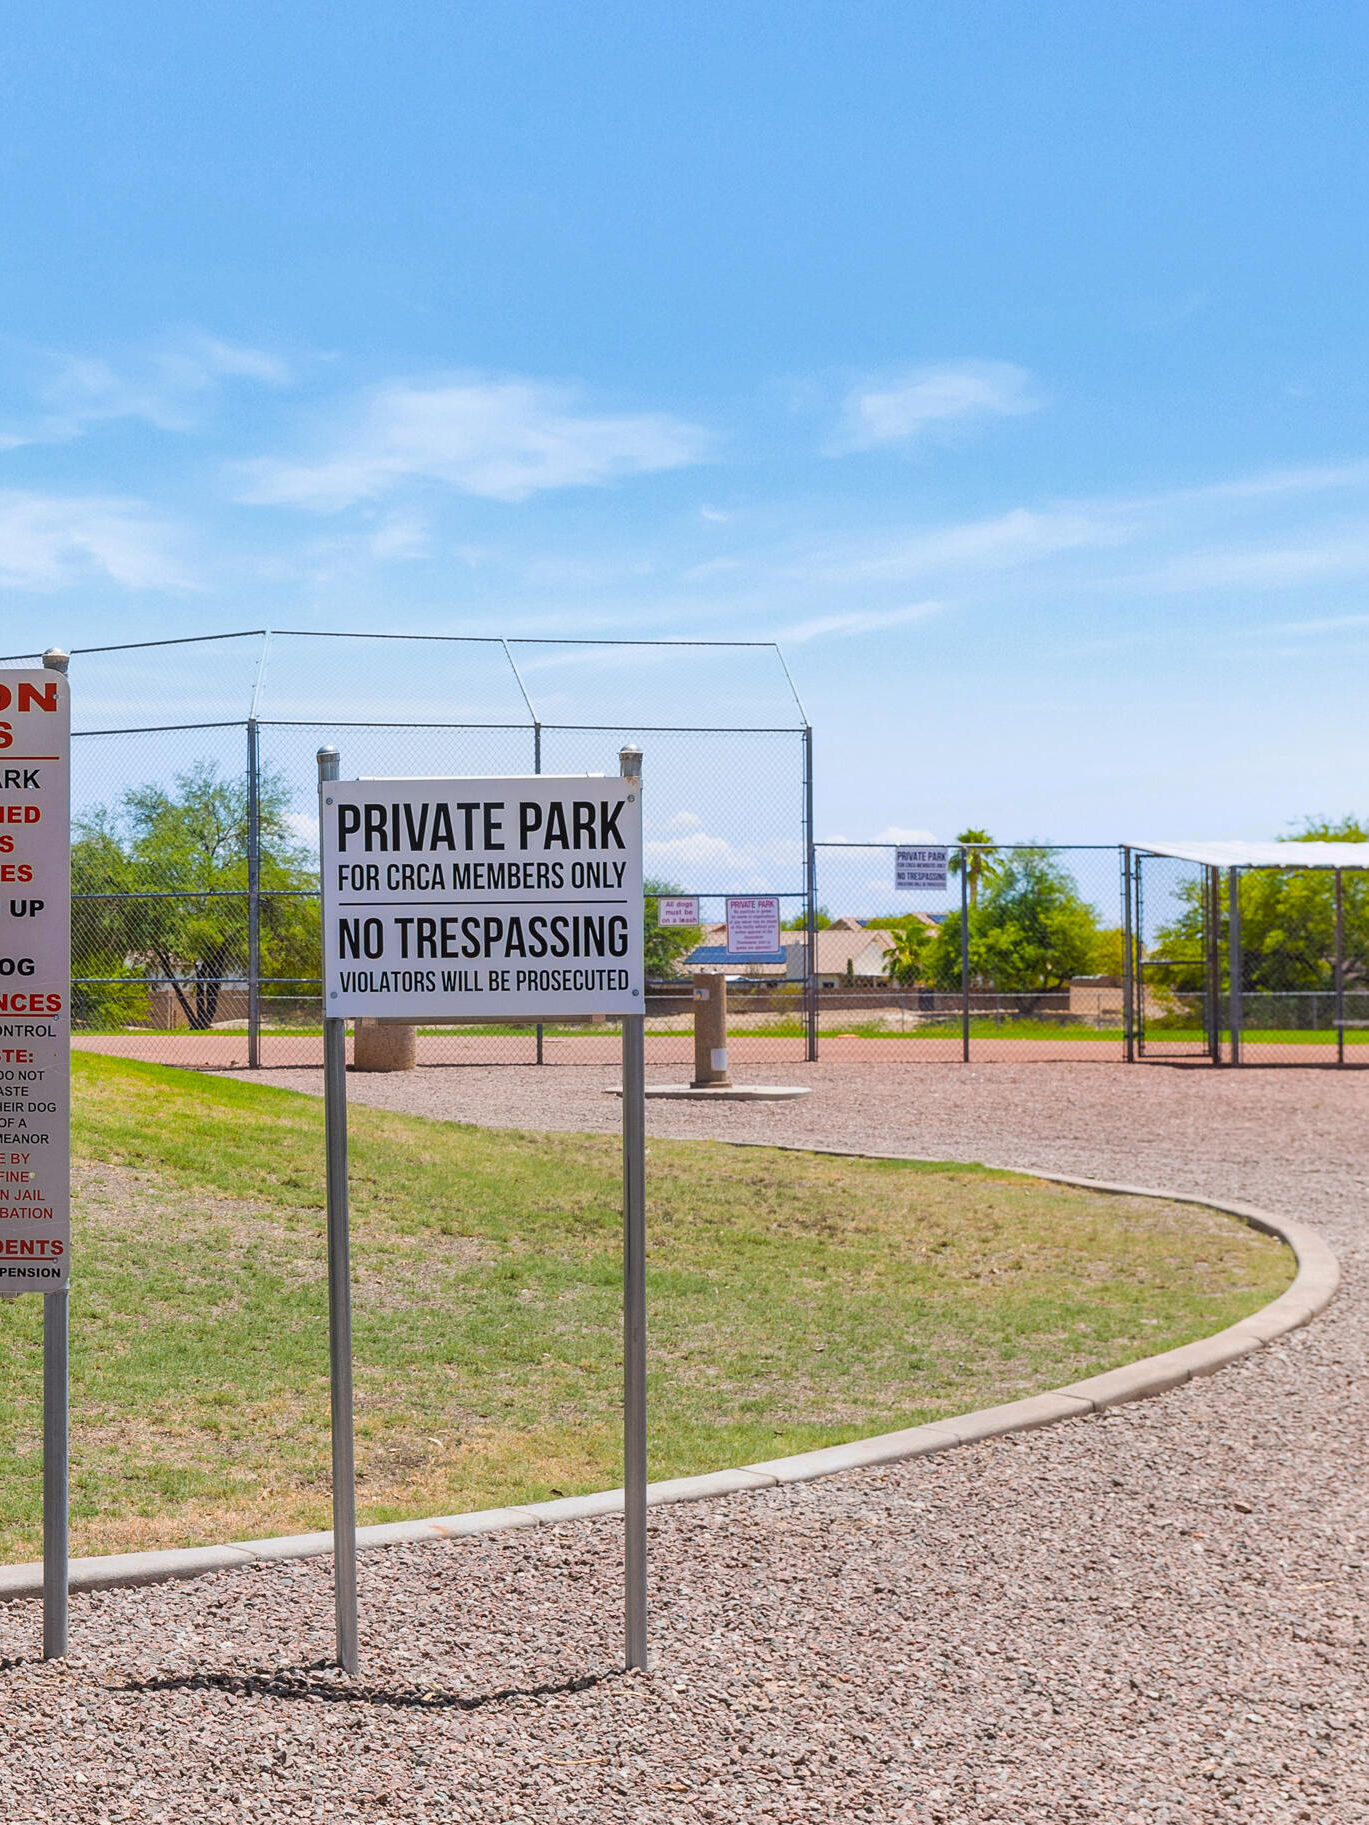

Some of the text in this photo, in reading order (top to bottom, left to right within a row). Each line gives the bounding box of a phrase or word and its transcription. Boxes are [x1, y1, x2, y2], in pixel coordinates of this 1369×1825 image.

[337, 800, 626, 853] PRIVATE PARK
[897, 851, 946, 861] PRIVATE PARK
[338, 861, 627, 891] FOR CRCA MEMBERS ONLY
[897, 872, 946, 880] NO TRESPASSING
[10, 899, 45, 918] UP
[730, 899, 775, 908] PRIVATE PARK
[338, 915, 628, 960] NO TRESPASSING
[339, 969, 629, 993] VIOLATORS WILL BE PROSECUTED
[18, 1070, 45, 1081] NOT
[28, 1102, 57, 1113] DOG
[17, 1118, 27, 1128] A
[10, 1153, 30, 1165] BY
[14, 1189, 46, 1201] JAIL
